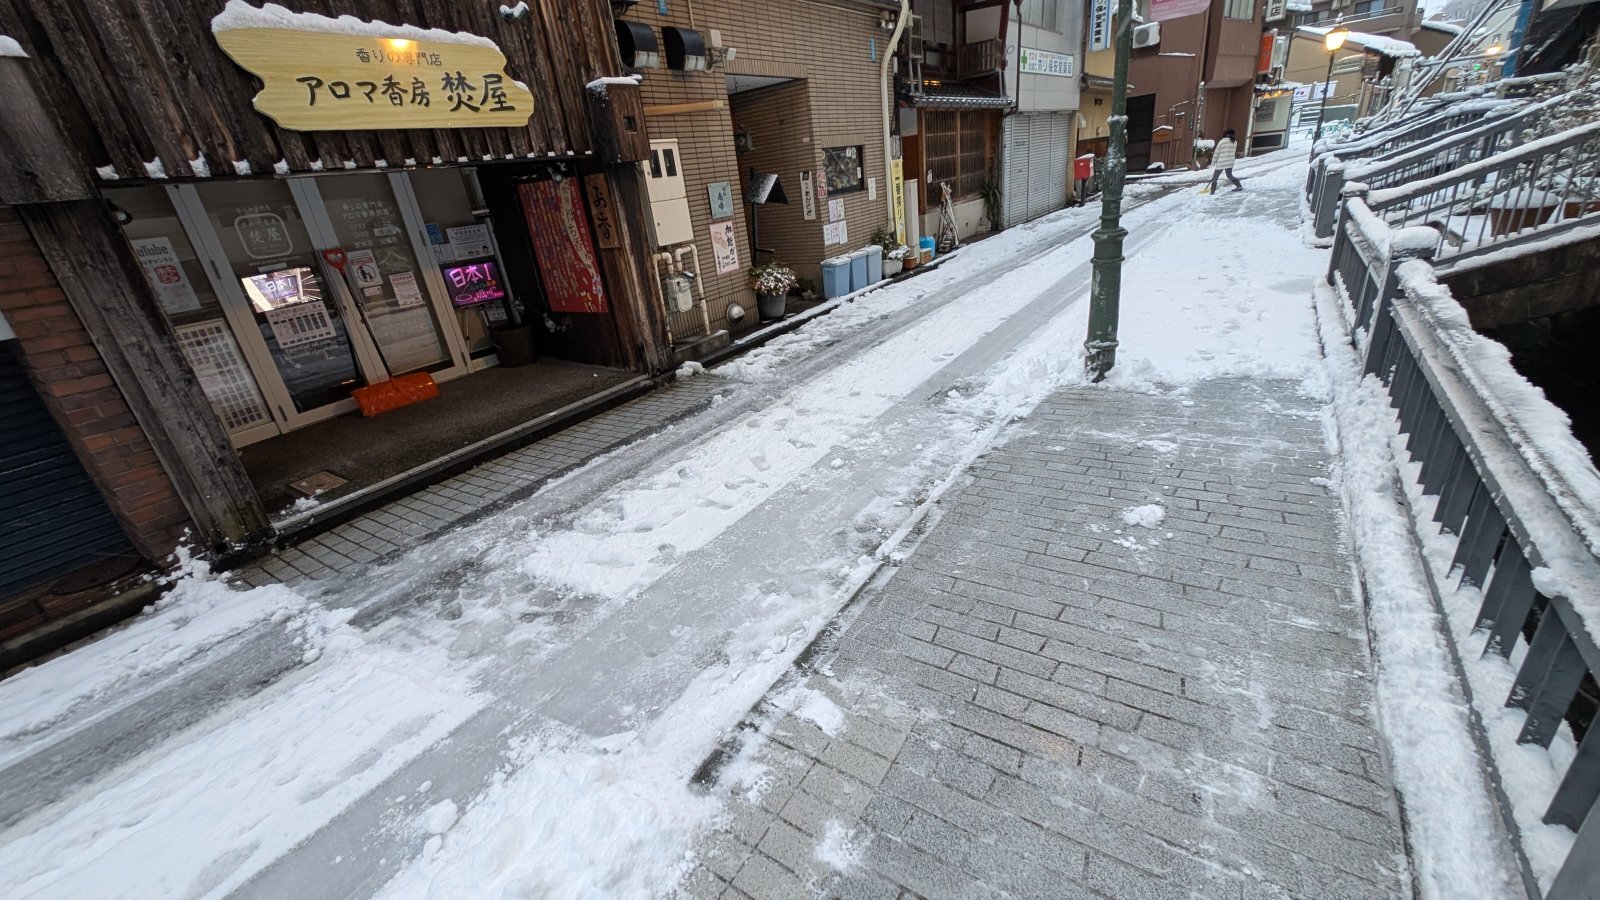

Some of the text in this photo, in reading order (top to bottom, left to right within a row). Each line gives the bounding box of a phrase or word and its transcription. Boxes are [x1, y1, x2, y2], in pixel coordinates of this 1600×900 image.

[355, 48, 442, 66] 香りの専門店
[296, 71, 516, 112] アロマ香房 焚屋
